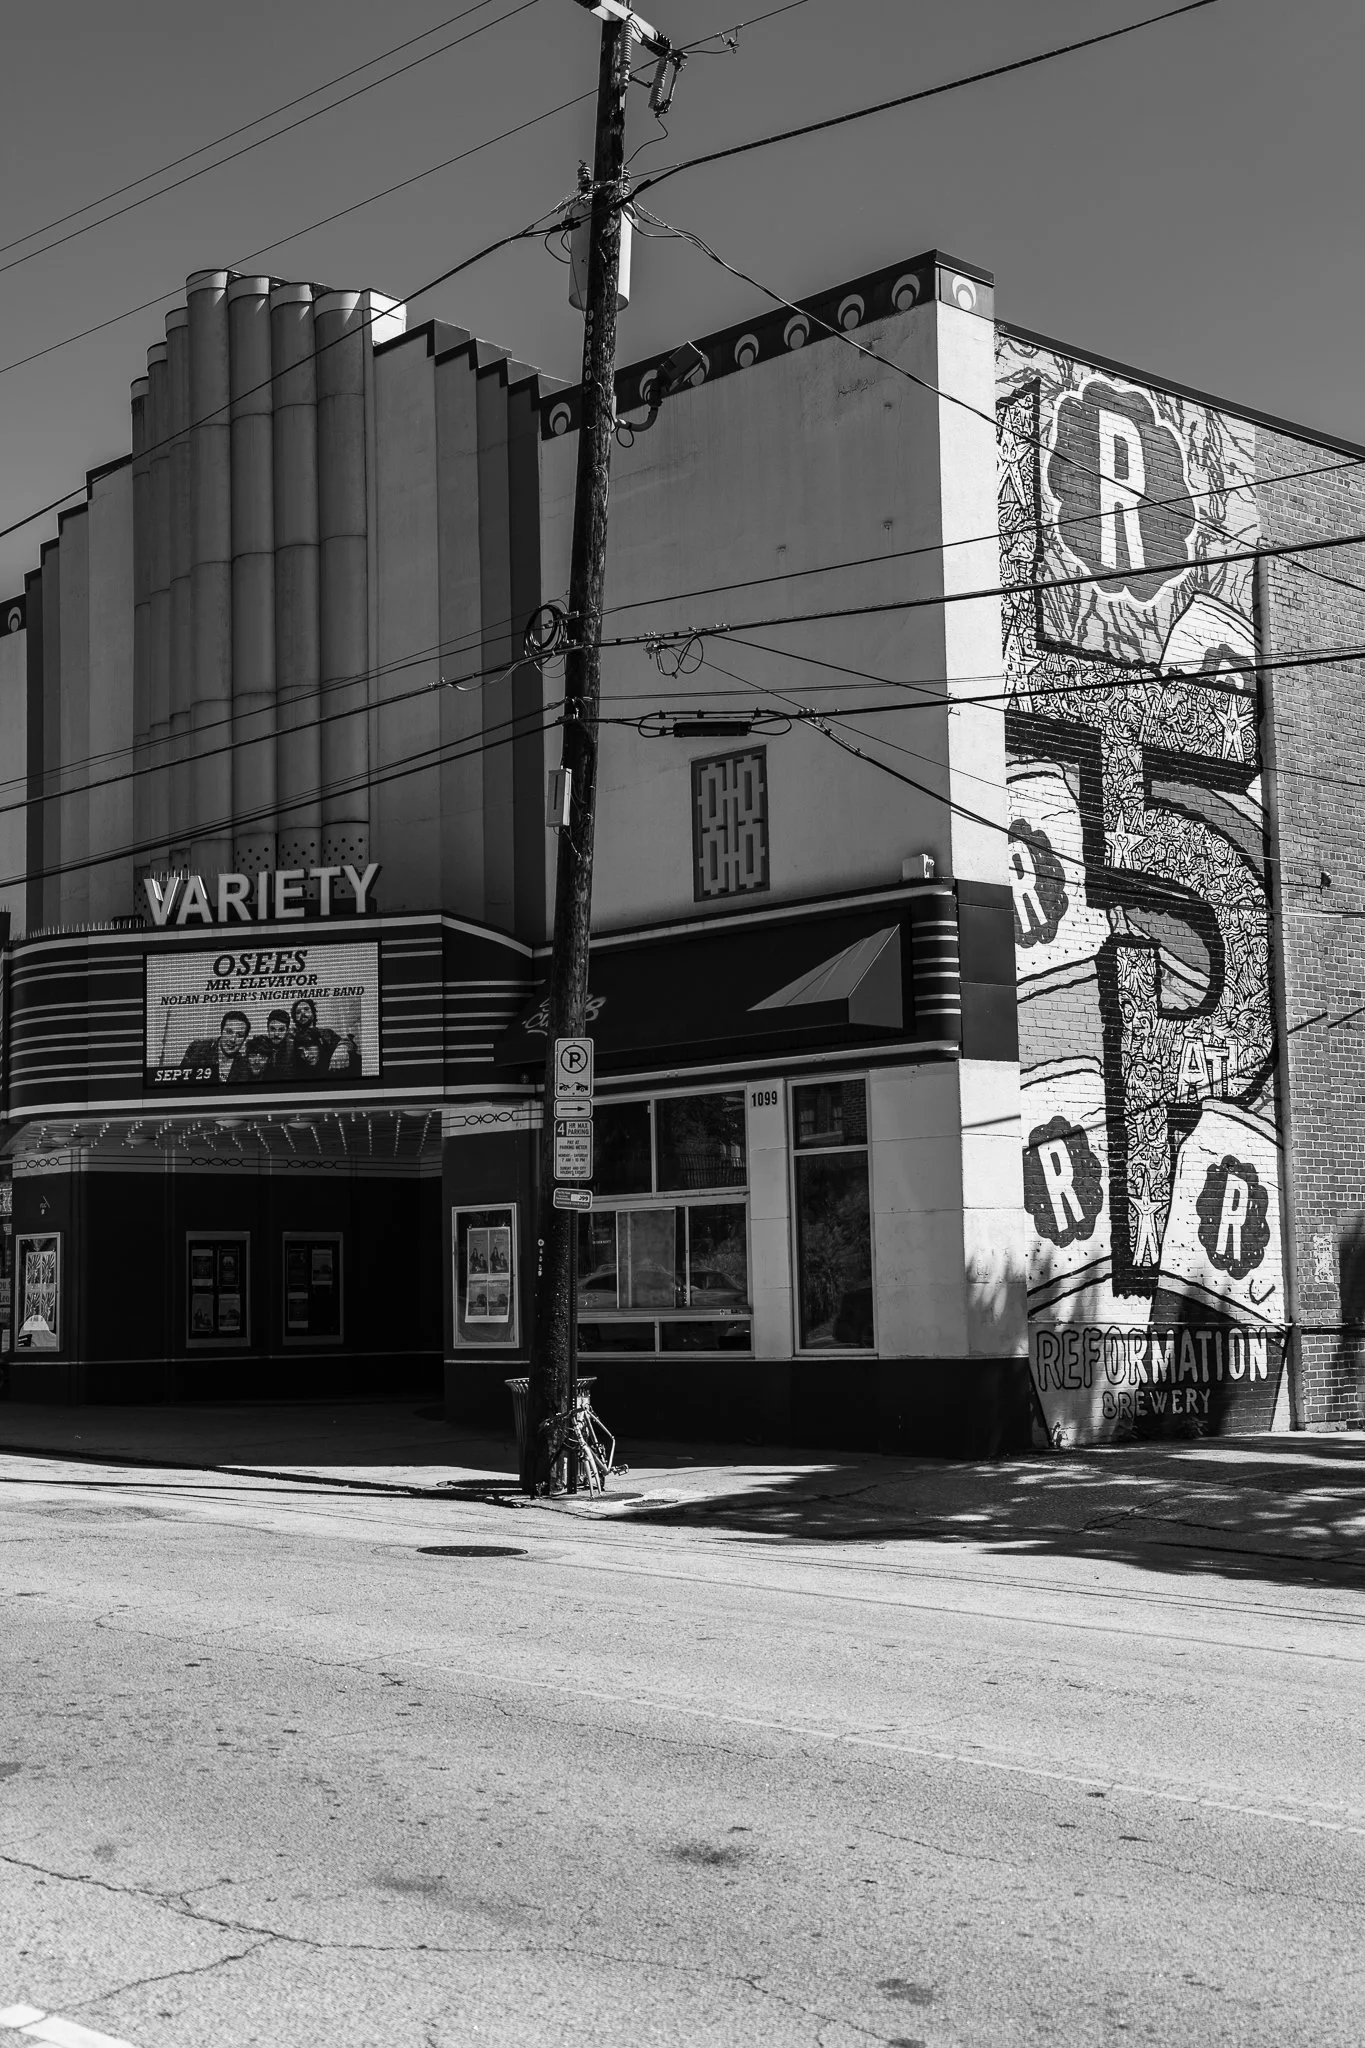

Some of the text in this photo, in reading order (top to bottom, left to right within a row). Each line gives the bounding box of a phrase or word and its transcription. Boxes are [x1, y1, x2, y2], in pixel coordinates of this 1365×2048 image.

[1098, 409, 1146, 570] R
[144, 863, 379, 926] VARIETY
[1007, 840, 1048, 933] R
[213, 950, 308, 977] OSEES
[160, 986, 365, 1006] NOLAN POTTER'S NIGHTMARE BAND
[205, 974, 318, 991] MR. ELEVATOR
[155, 1067, 212, 1082] SEPT 29
[751, 1090, 778, 1107] 1099
[557, 1122, 565, 1136] 4
[1038, 1138, 1085, 1232] R
[1216, 1173, 1249, 1261] R
[1036, 1326, 1268, 1391] REFORMATION
[1102, 1388, 1211, 1419] BREWERY
